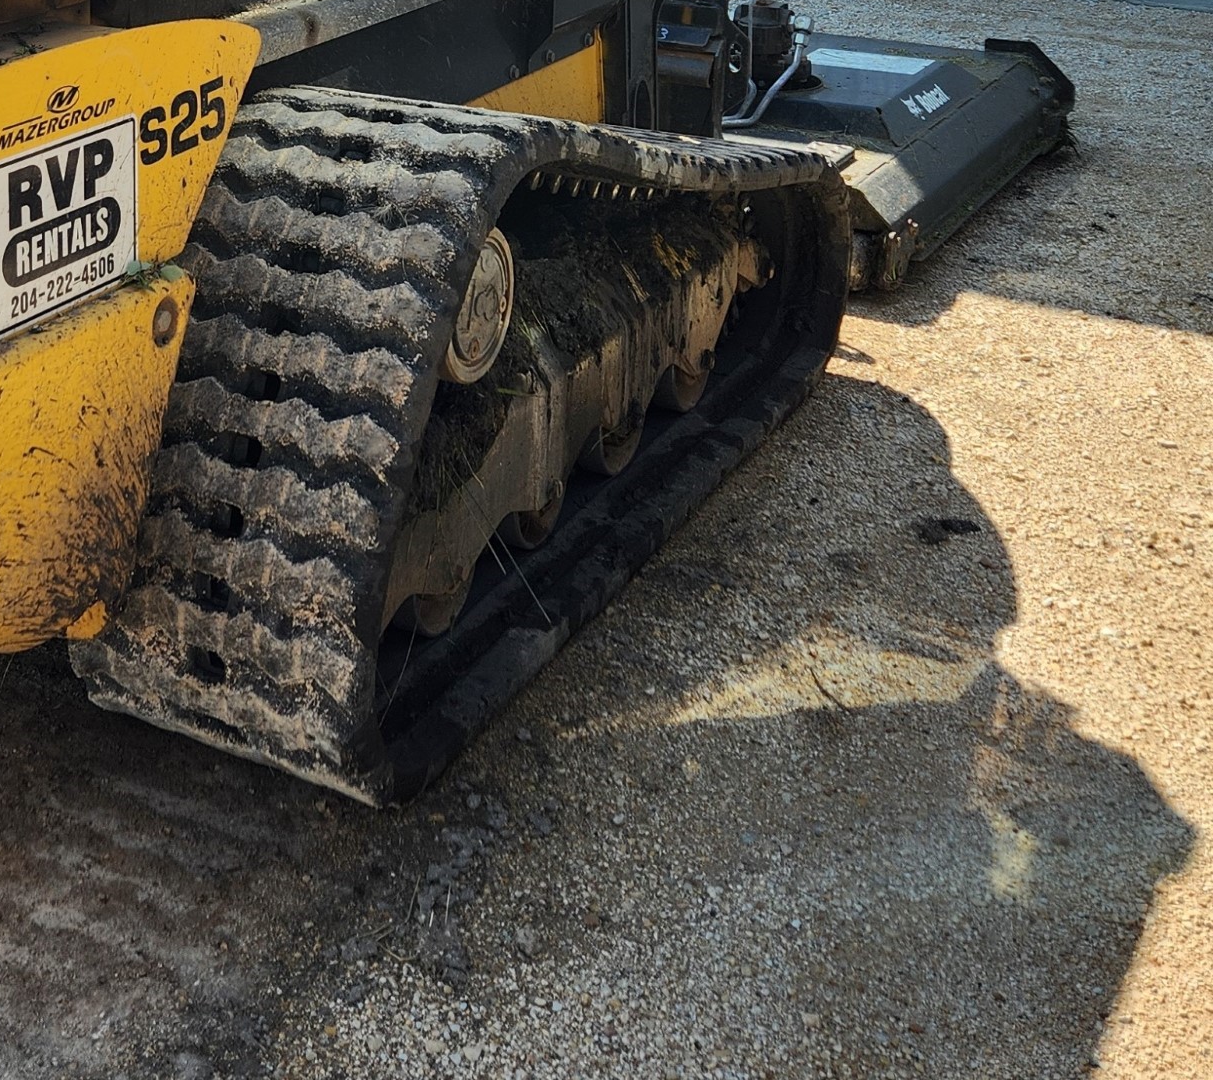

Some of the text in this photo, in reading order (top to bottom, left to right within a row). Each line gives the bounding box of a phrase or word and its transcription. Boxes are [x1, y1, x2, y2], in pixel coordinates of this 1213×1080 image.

[139, 75, 226, 166] S25
[914, 83, 951, 114] Bobcat
[8, 138, 114, 231] RVP
[16, 207, 109, 277] RENTALS
[11, 253, 115, 319] 204-222-4506
